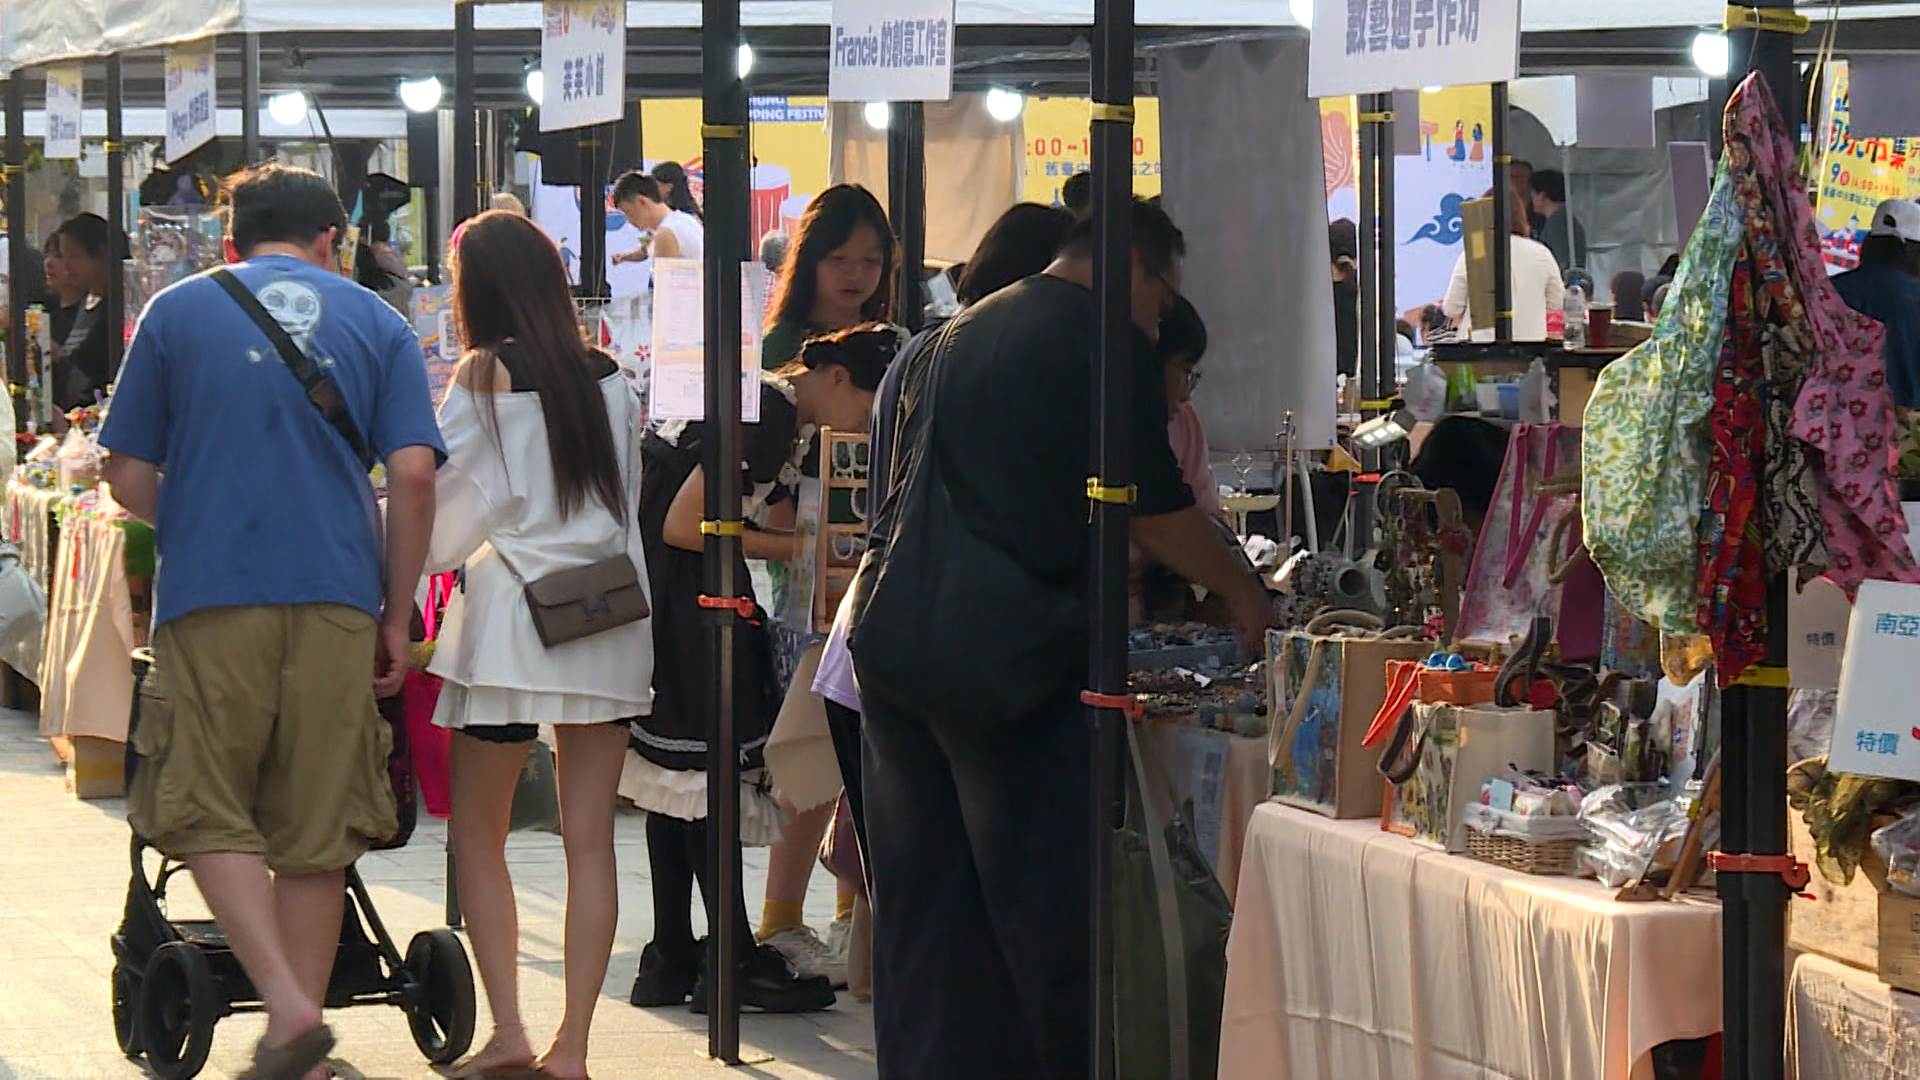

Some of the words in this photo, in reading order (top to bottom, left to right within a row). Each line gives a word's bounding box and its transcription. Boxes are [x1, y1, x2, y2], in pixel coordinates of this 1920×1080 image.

[834, 24, 878, 67] Francie
[879, 17, 948, 67] 的創意工作室
[1806, 631, 1835, 646] 特價
[1855, 730, 1900, 756] 特價
